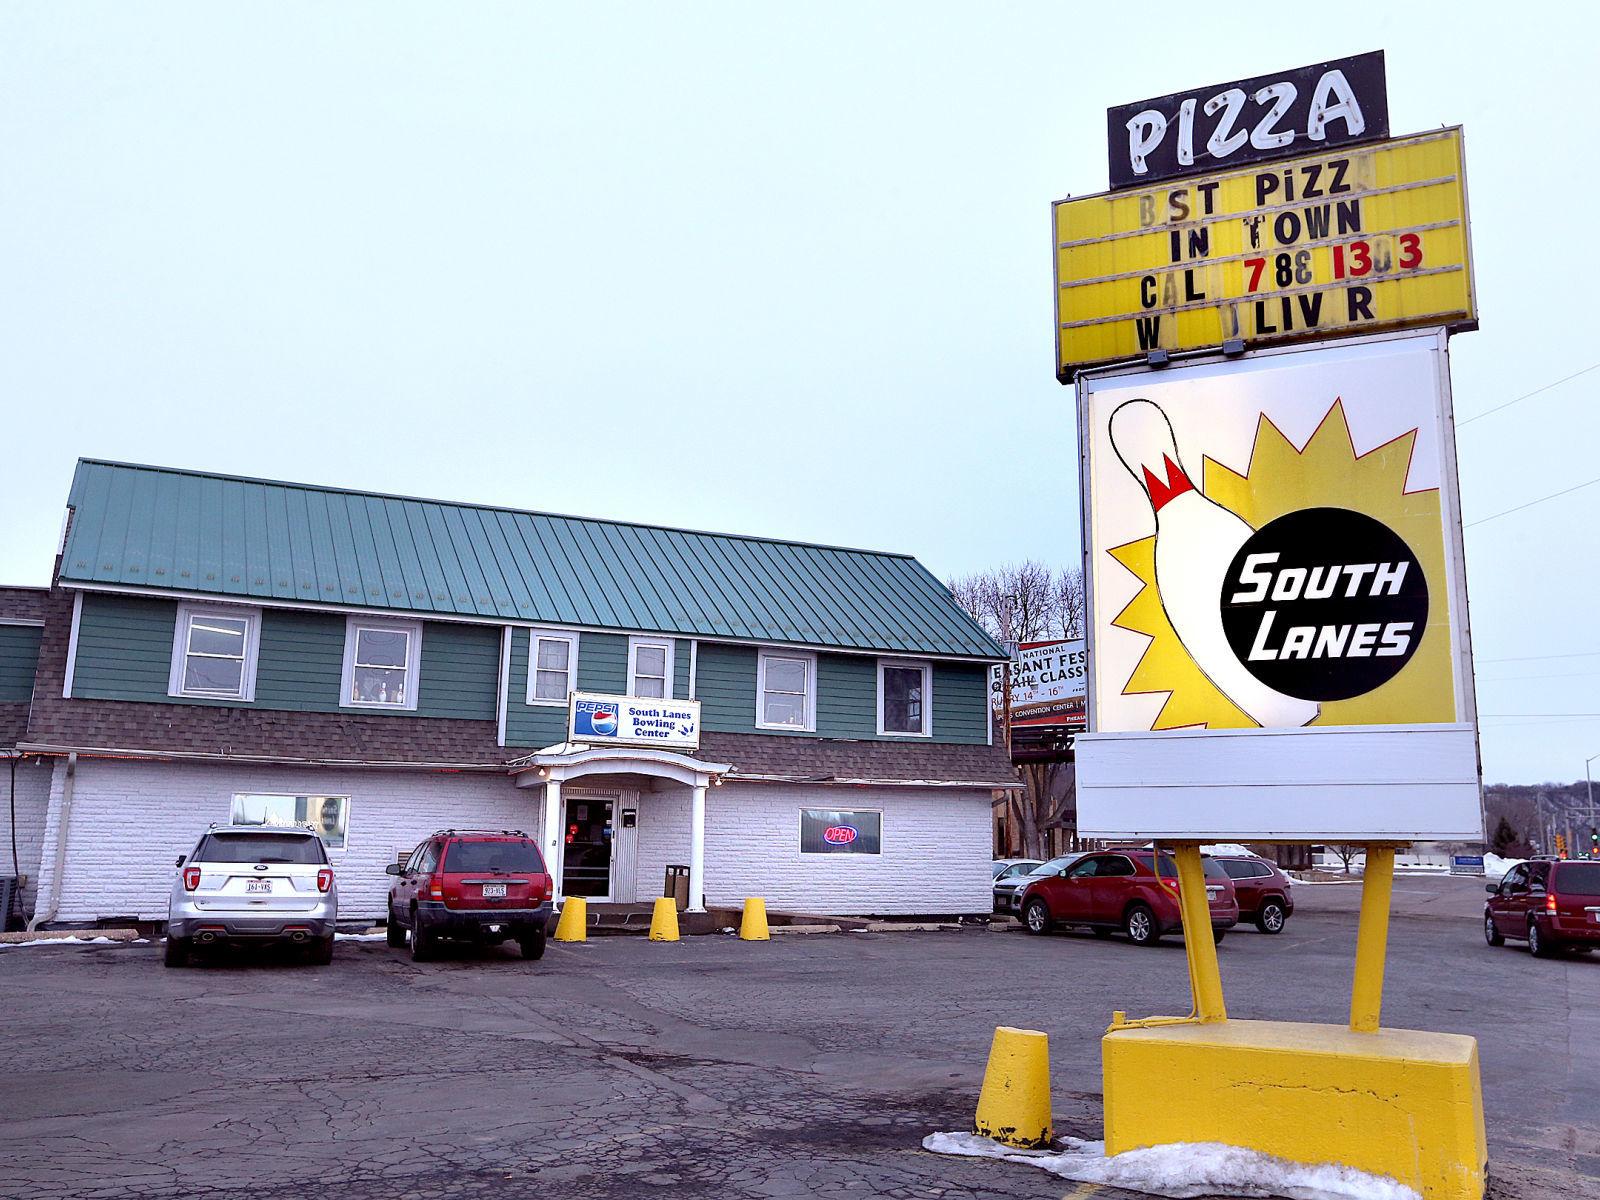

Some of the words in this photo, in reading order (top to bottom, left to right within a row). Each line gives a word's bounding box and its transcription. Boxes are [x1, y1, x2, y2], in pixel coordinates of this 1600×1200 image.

[1126, 69, 1365, 175] PIZZA
[1171, 226, 1209, 262] IN
[1243, 199, 1361, 248] TOWN
[1231, 552, 1410, 603] SOUTH
[1248, 610, 1415, 661] LANES
[1023, 645, 1065, 659] NATIONAL
[1059, 650, 1085, 667] FES
[577, 701, 616, 713] PEPSI
[629, 707, 659, 718] South
[663, 709, 691, 720] Lanes
[1015, 706, 1051, 717] CONVENTION
[1053, 702, 1074, 711] CENTER
[632, 717, 675, 730] Bowling
[635, 728, 670, 738] Center
[826, 828, 854, 843] OPEN
